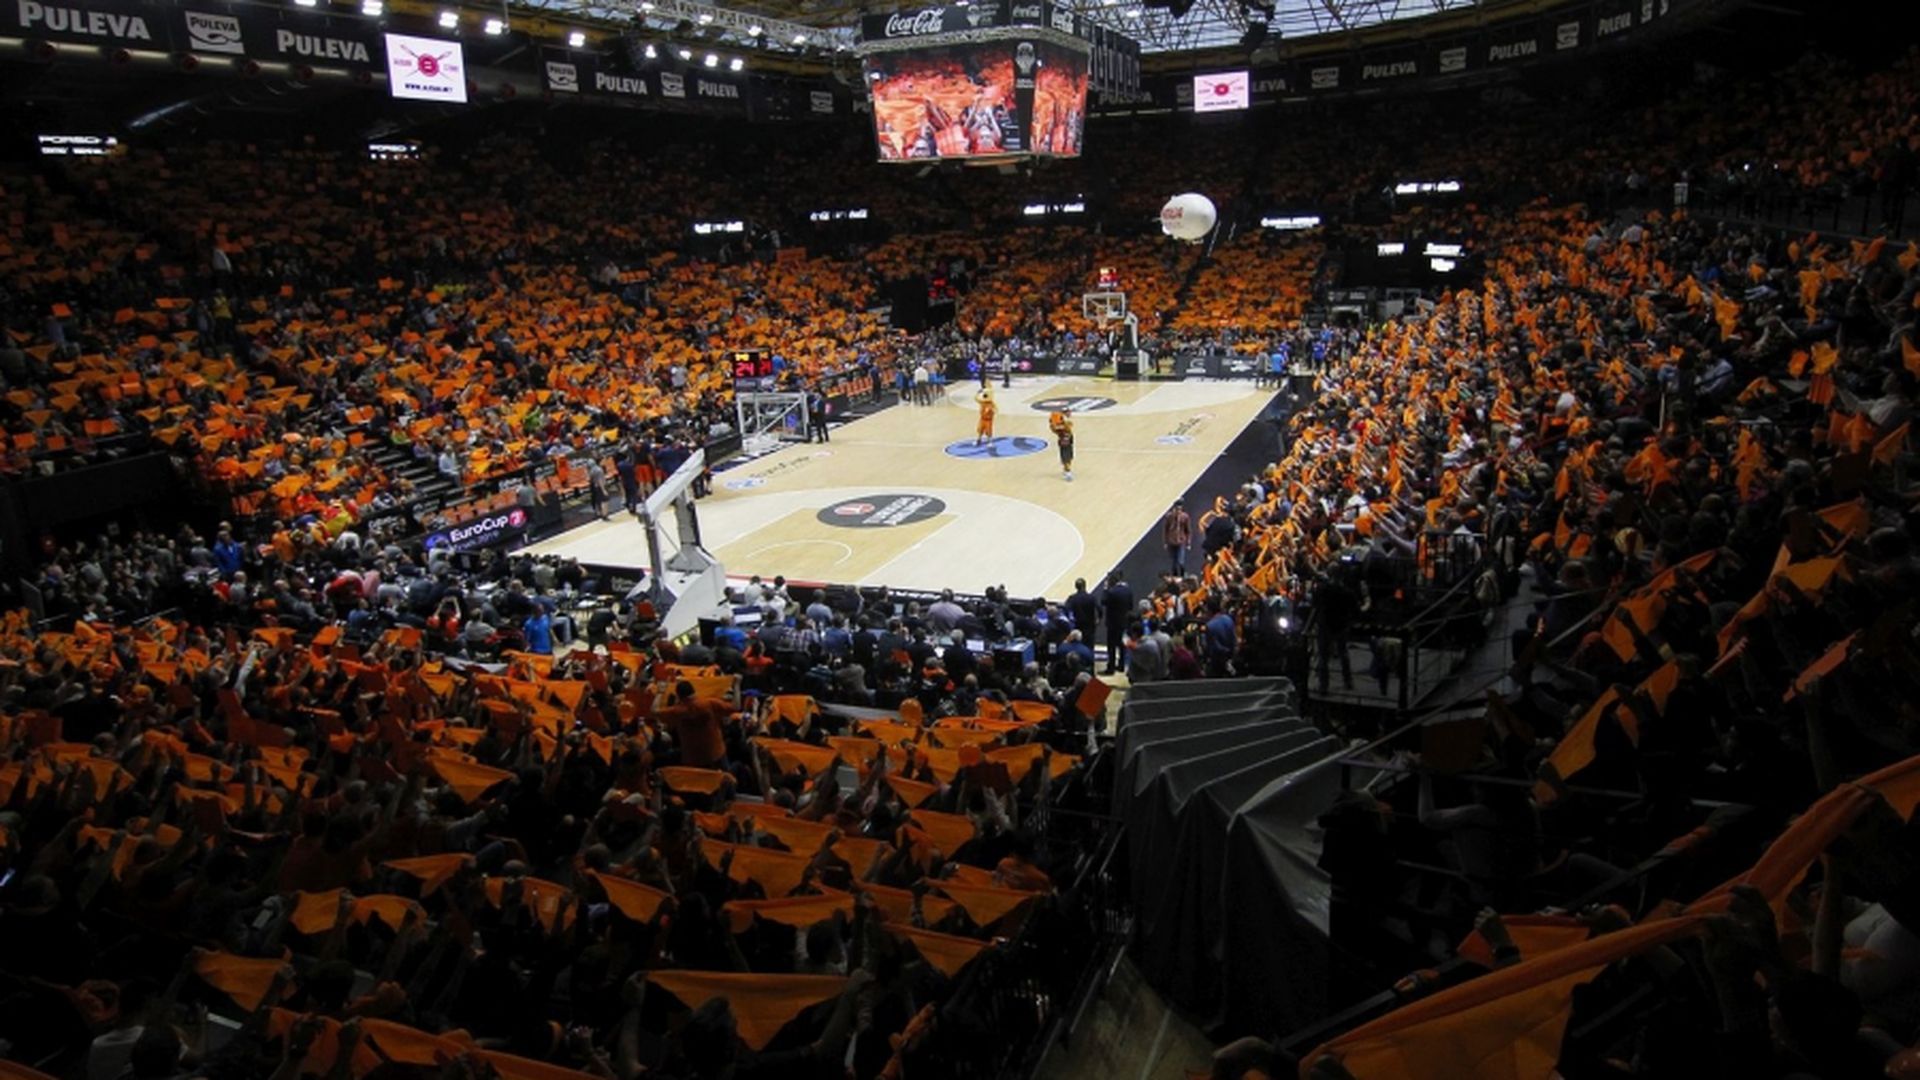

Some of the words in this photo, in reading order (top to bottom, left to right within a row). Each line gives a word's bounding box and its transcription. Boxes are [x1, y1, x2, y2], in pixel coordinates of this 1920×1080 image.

[18, 0, 152, 40] PULEVA
[190, 16, 237, 33] PULEVA
[276, 29, 370, 62] PULEVA
[1489, 39, 1537, 61] PULEVA
[1363, 61, 1417, 79] PULEVA
[596, 72, 648, 95] PULEVA
[698, 80, 739, 98] PULEVA
[1252, 79, 1286, 93] LEVA
